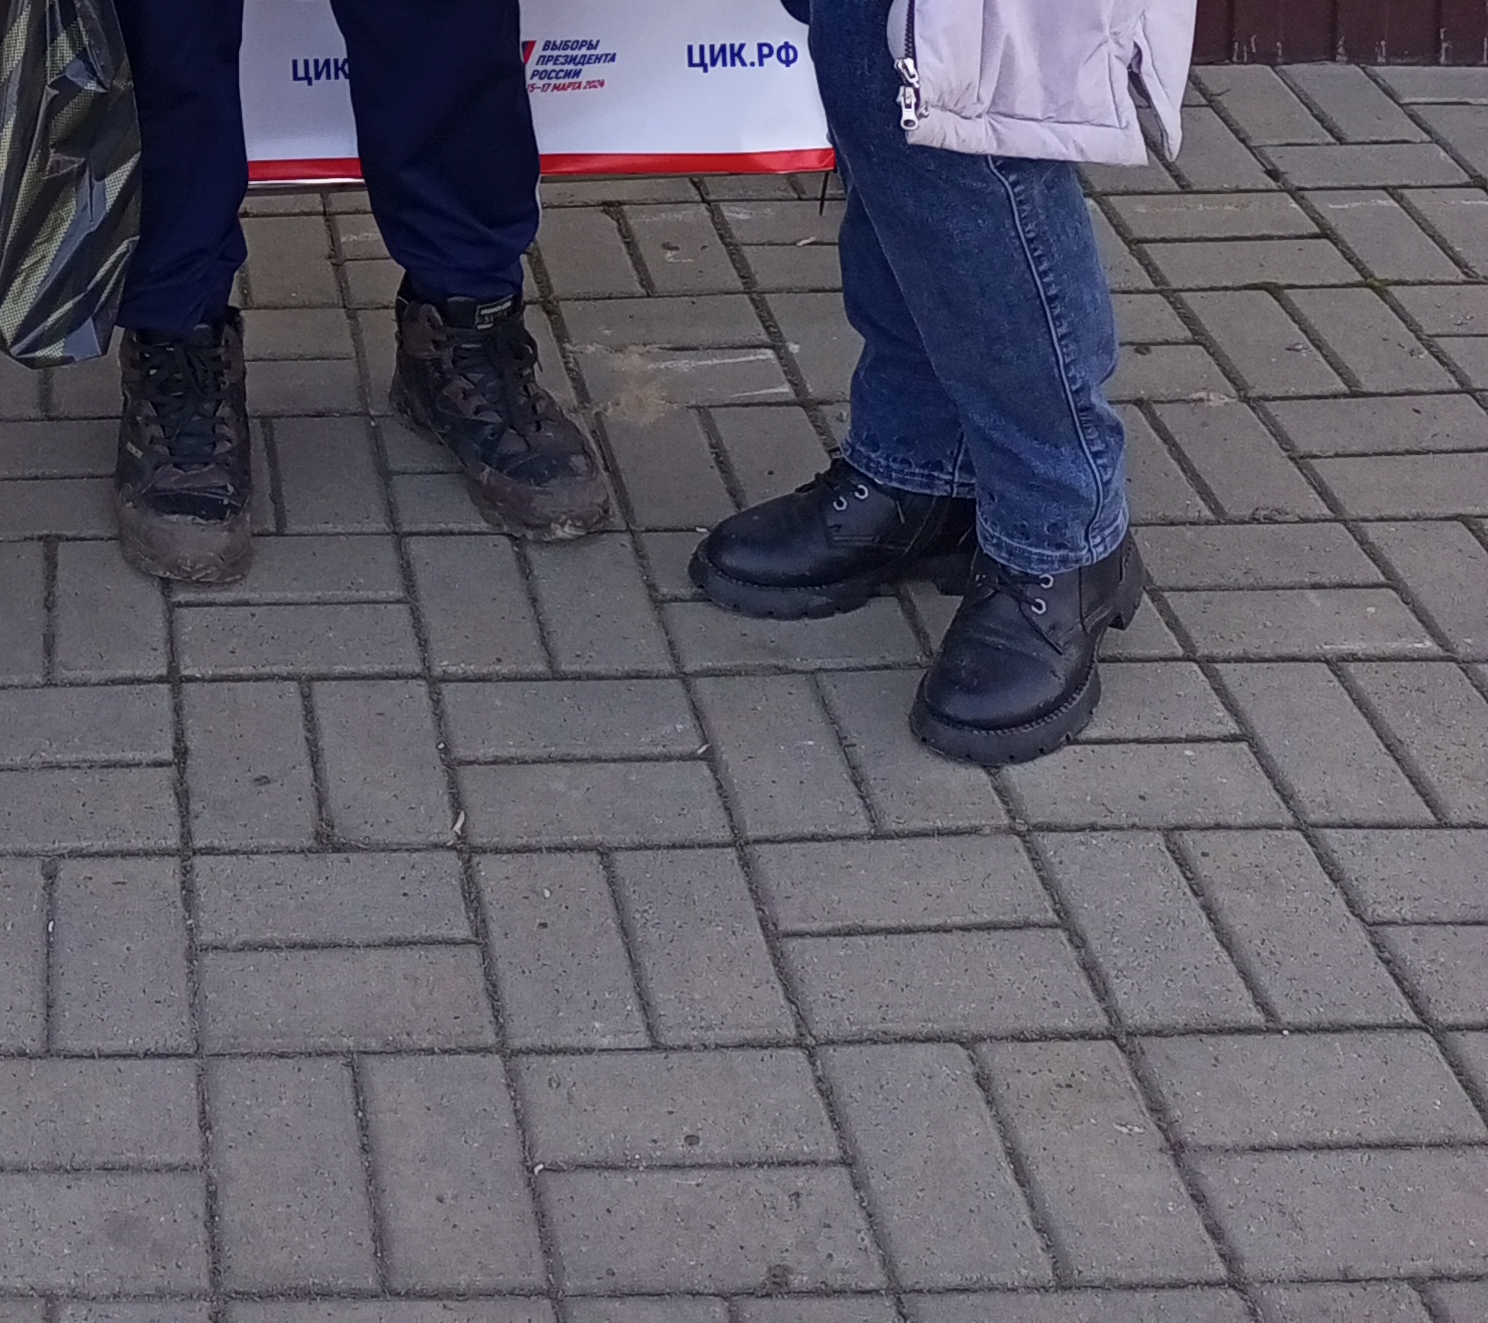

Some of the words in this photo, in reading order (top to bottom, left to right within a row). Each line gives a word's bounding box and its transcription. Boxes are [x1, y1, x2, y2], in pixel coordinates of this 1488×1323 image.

[542, 39, 600, 51] ВЫБОРЫ
[535, 53, 616, 67] ПРЕЗИДЕНТА
[687, 41, 799, 73] ЦИК.РФ
[530, 68, 582, 80] РОССИИ
[551, 81, 582, 92] МАРТА
[583, 79, 605, 89] 2024
